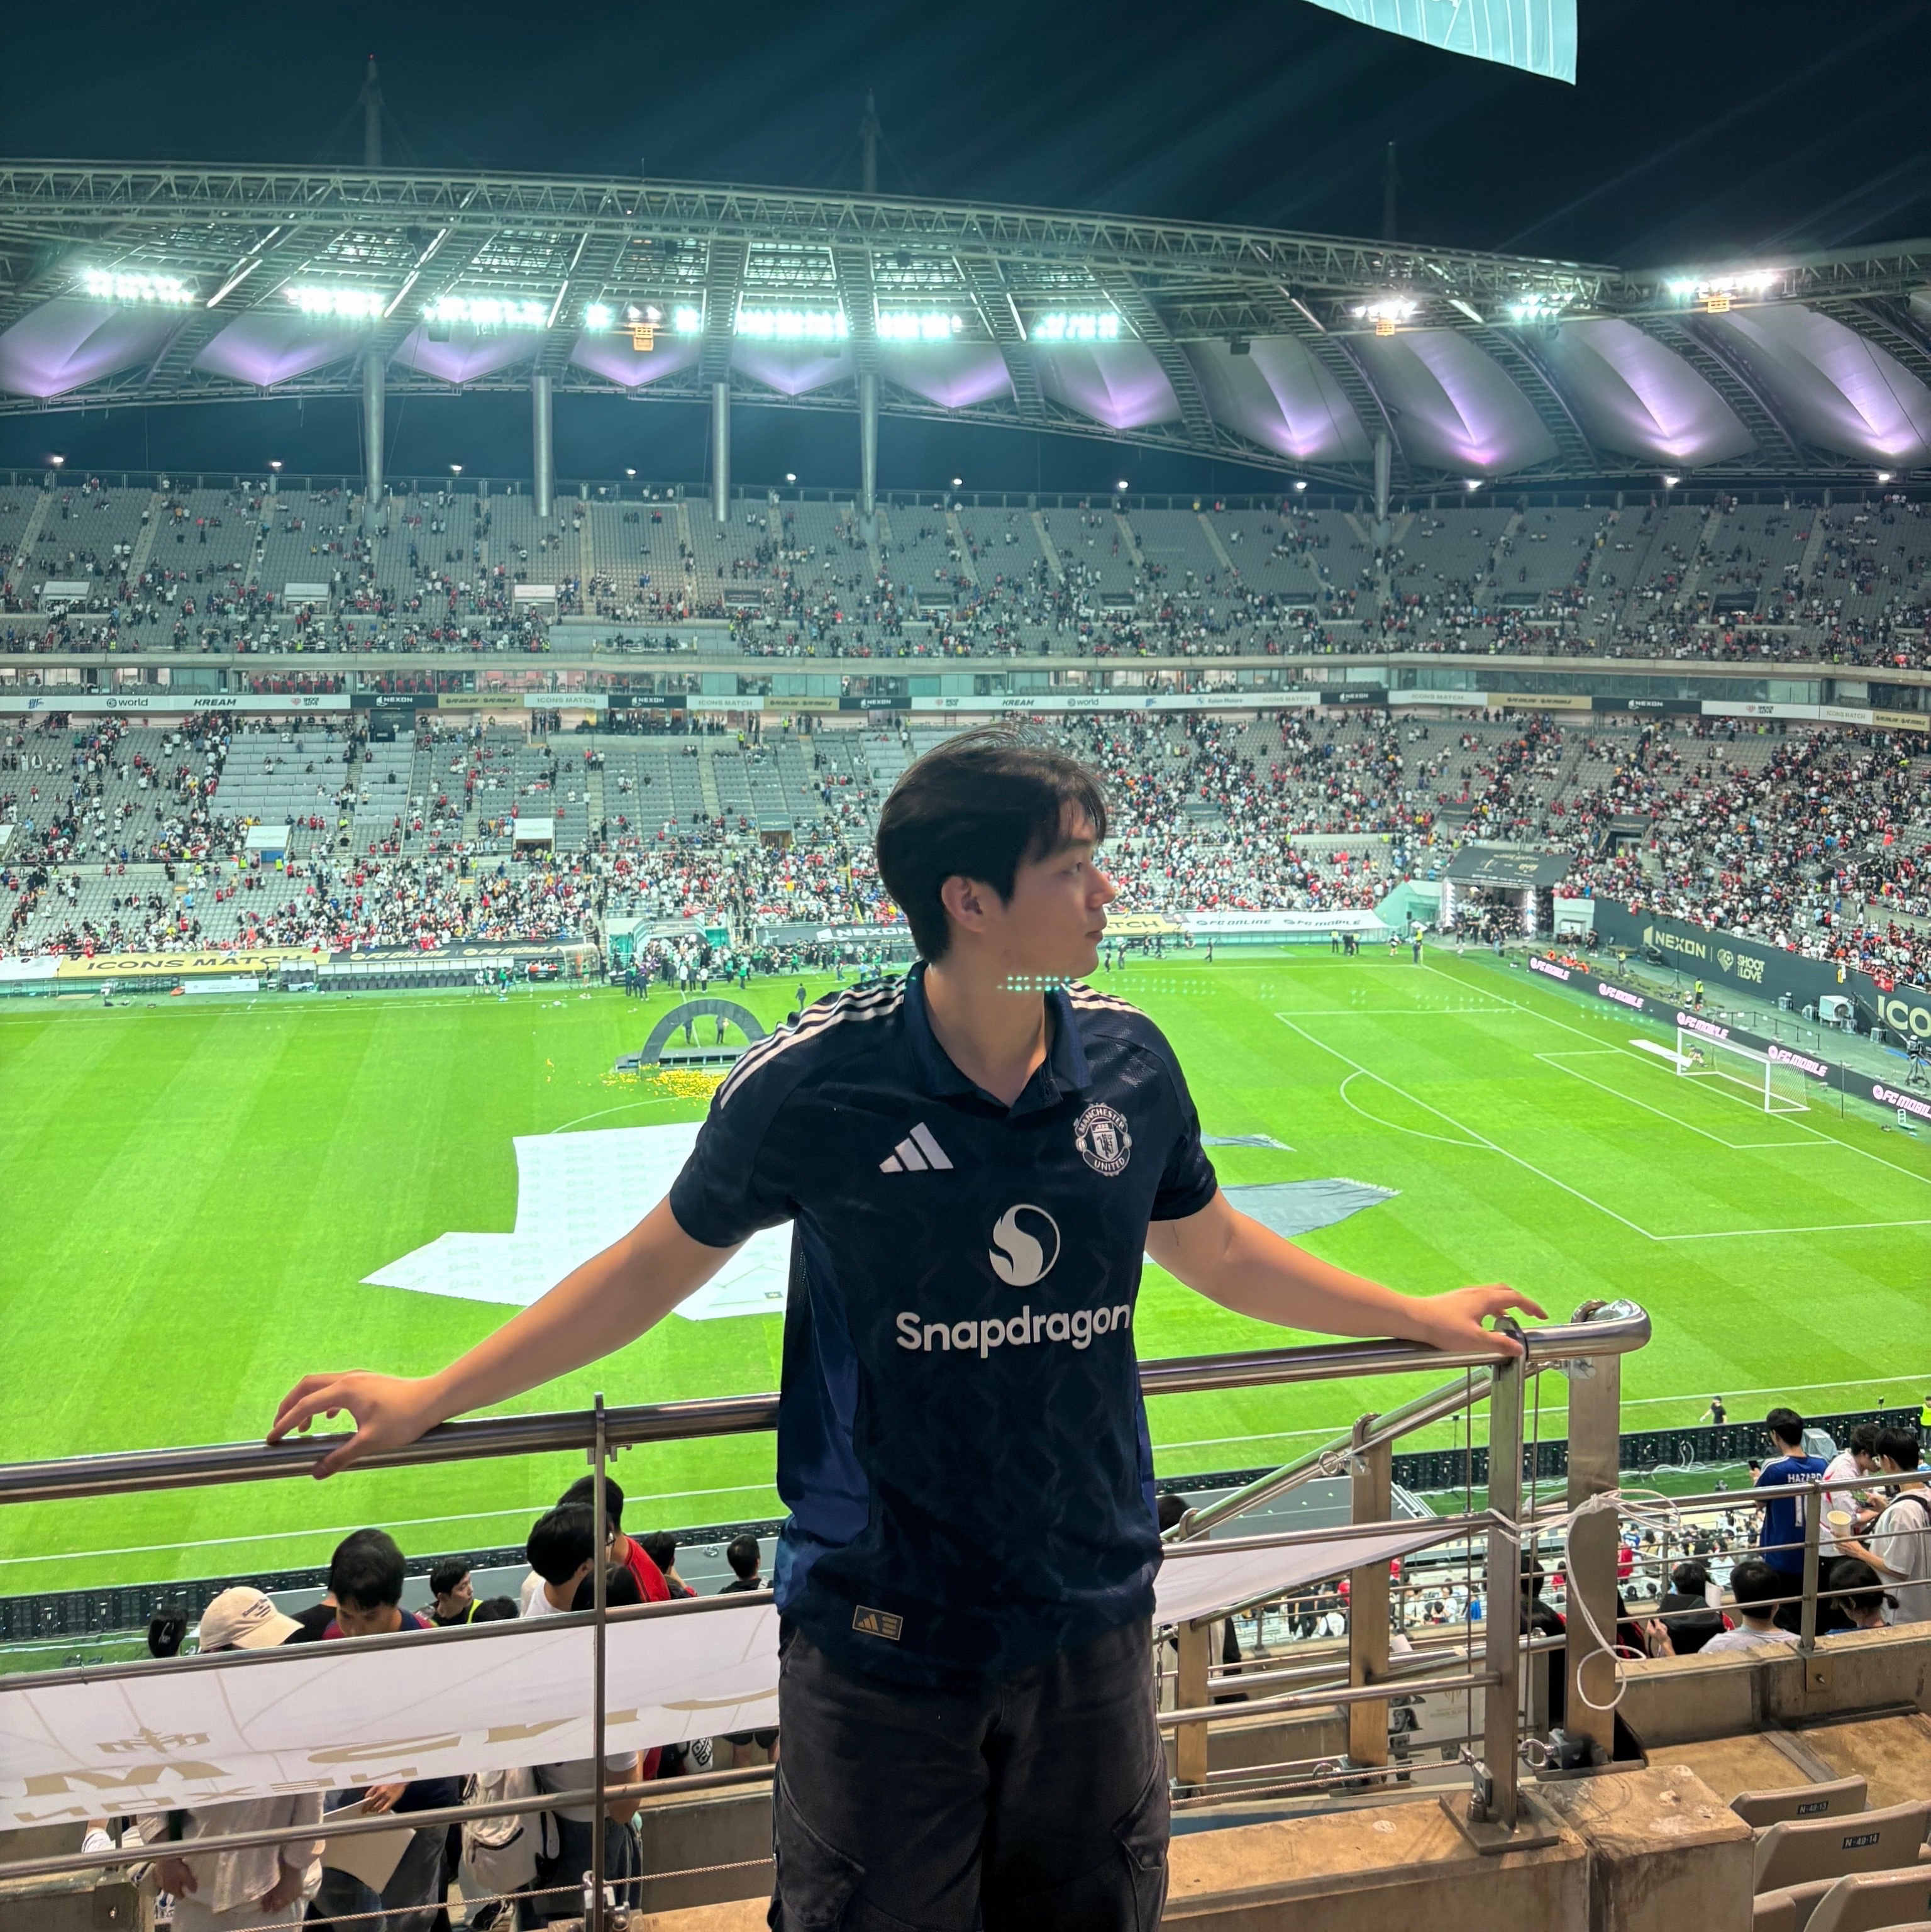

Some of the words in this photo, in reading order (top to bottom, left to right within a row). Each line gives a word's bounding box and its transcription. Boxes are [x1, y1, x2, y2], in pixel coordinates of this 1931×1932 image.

[119, 698, 148, 706] world
[836, 926, 912, 937] NEXON
[478, 947, 502, 955] FC
[1656, 930, 1706, 959] NEXON
[87, 959, 185, 970] ICONS
[192, 955, 302, 967] MATCH
[365, 952, 389, 960] FC
[389, 950, 451, 958] ONLINE
[1737, 954, 1765, 973] SHOOT
[1536, 960, 1547, 972] FC
[1544, 963, 1571, 980] MOBILE
[1740, 967, 1762, 984] LOVE
[1606, 986, 1617, 998] FC
[1614, 989, 1644, 1008] MOBILE
[1685, 1015, 1698, 1028] FC
[1694, 1019, 1729, 1040] MOBILE
[1776, 1049, 1793, 1063] FC
[1790, 1055, 1828, 1077] MOBILE
[1882, 1089, 1900, 1104] FC
[1078, 1108, 1125, 1133] MANCHESTER
[1094, 1157, 1125, 1171] UNITED
[895, 1304, 1131, 1358] Snapdragon
[1787, 1472, 1822, 1483] HAZARD
